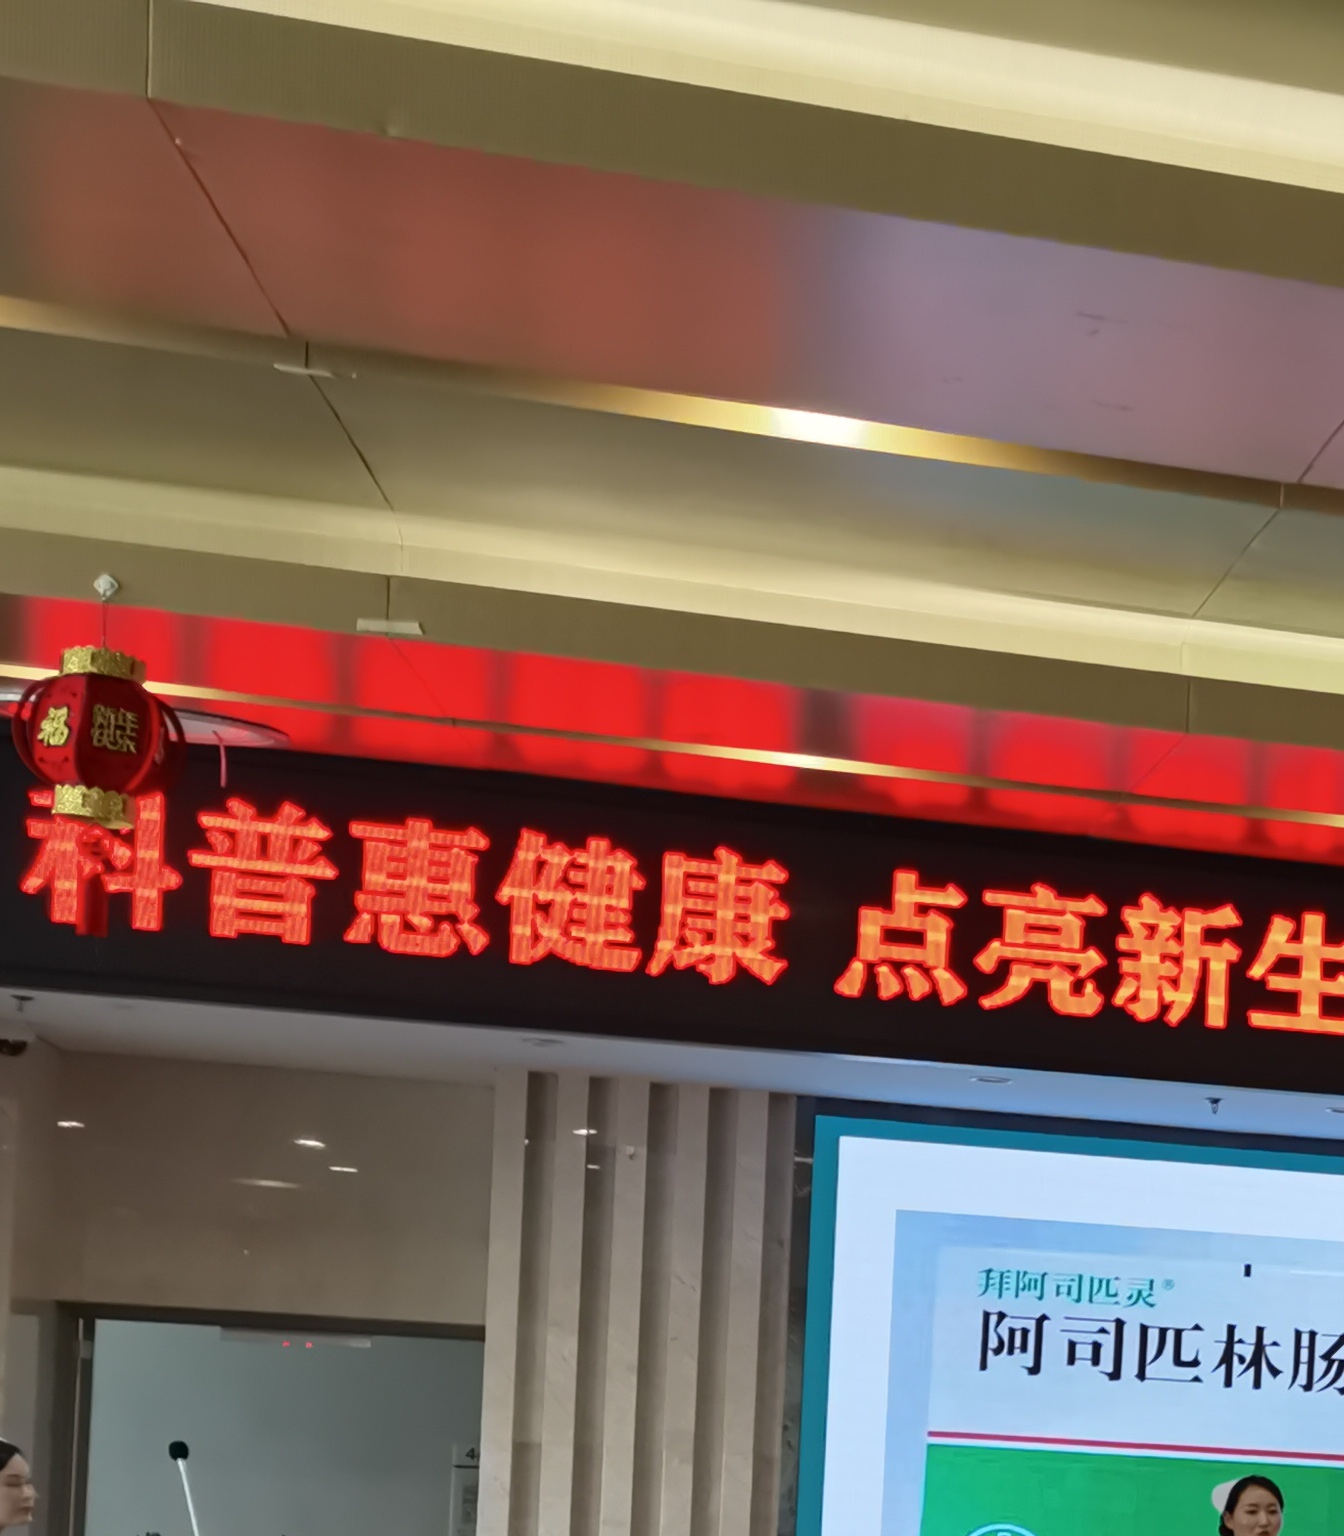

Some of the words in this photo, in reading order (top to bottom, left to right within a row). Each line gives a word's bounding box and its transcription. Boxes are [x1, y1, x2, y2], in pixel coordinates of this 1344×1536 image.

[37, 706, 70, 746] 福
[22, 790, 788, 985] 科普惠健康
